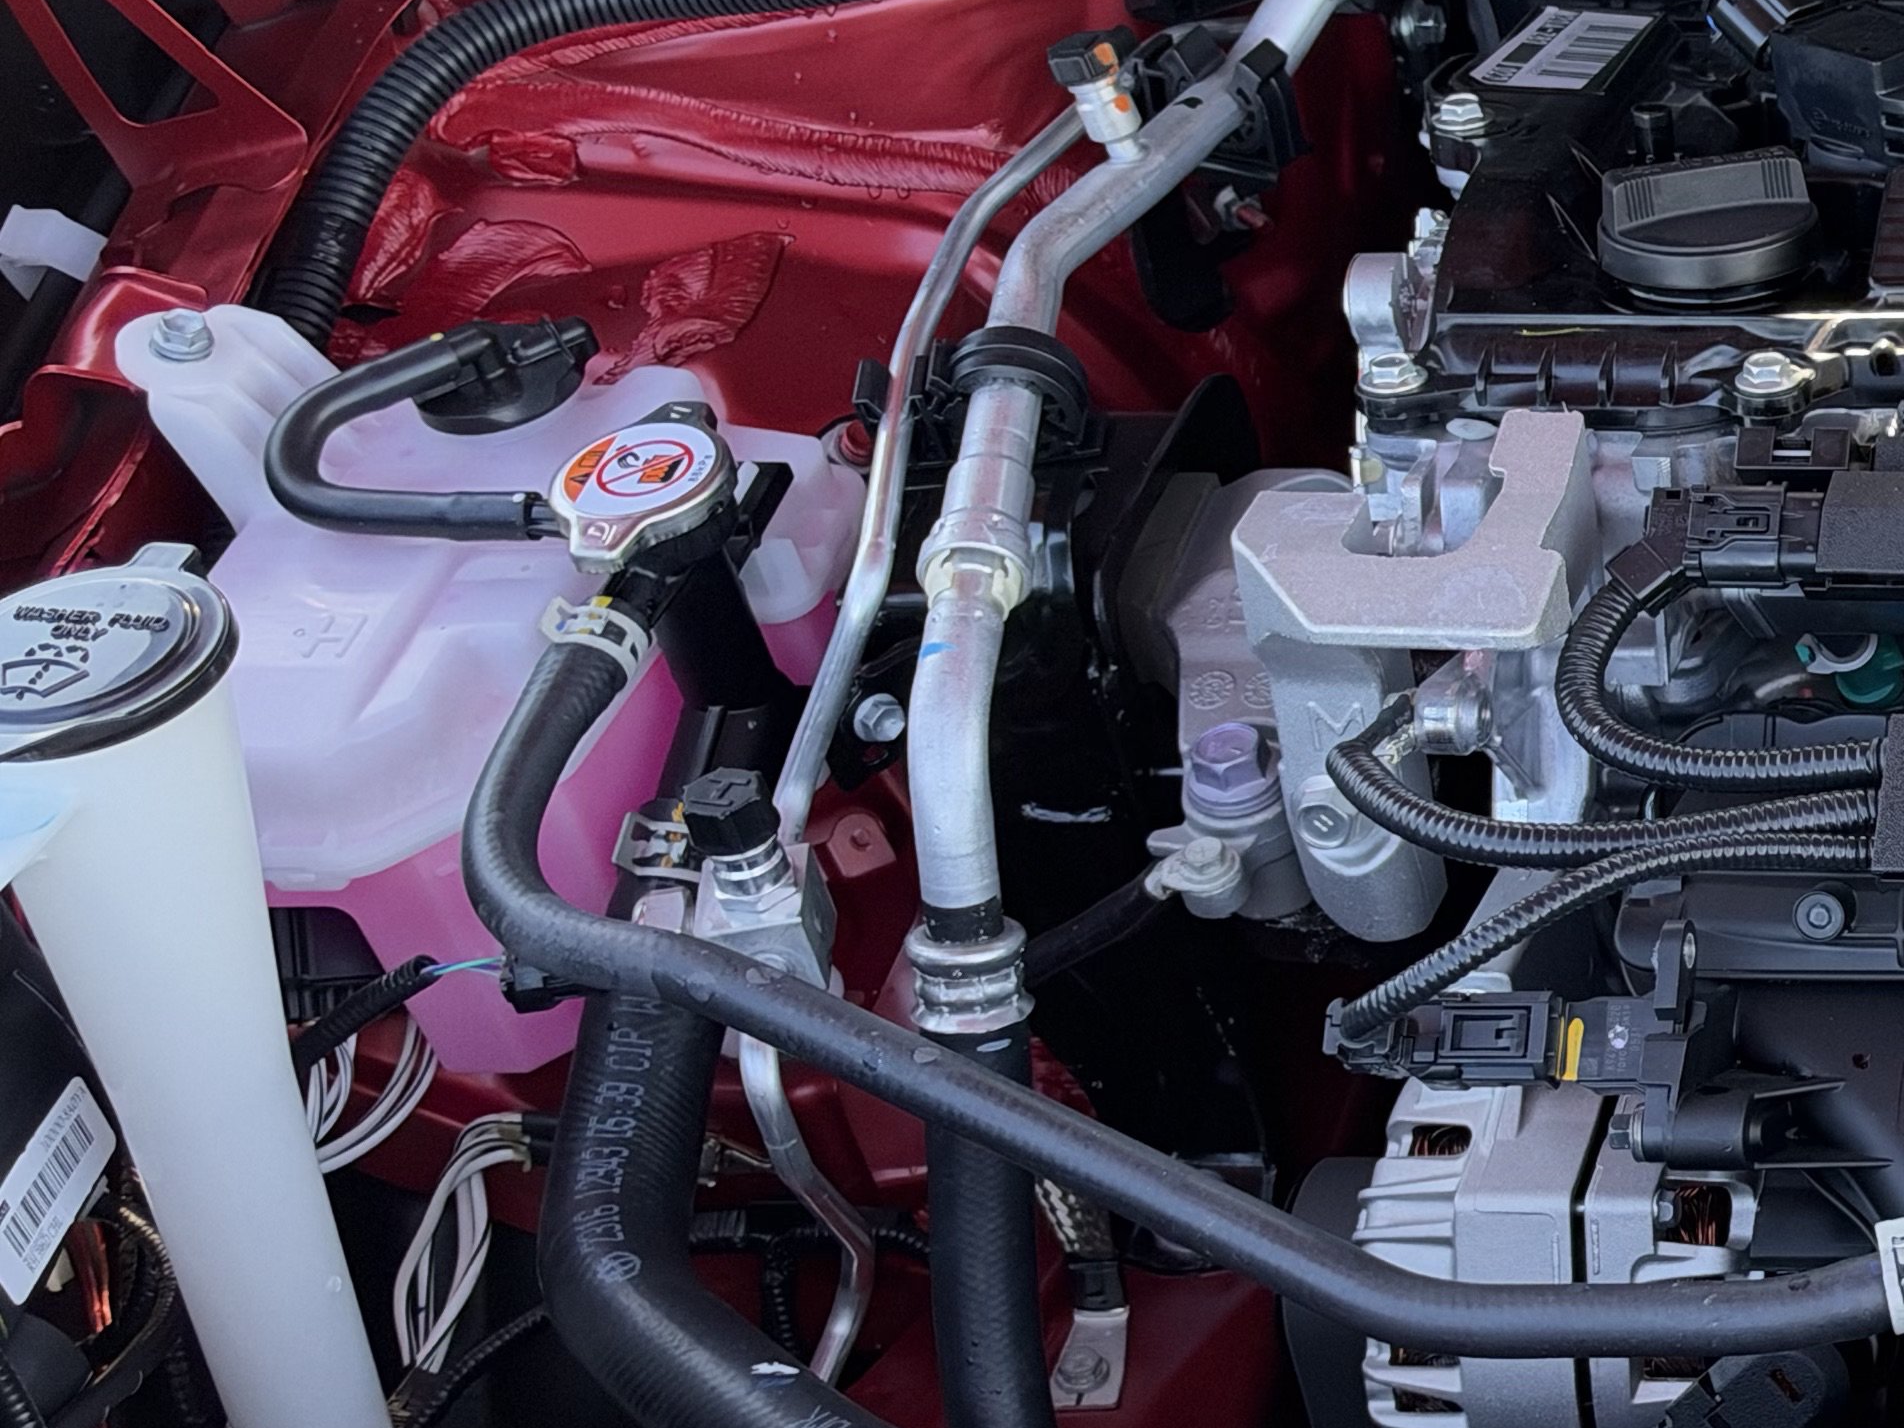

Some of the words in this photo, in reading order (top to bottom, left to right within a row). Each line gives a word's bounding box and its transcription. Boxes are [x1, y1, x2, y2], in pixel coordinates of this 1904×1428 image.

[13, 605, 102, 625] WASHER
[108, 613, 170, 633] FLUID
[50, 623, 110, 642] ONLY
